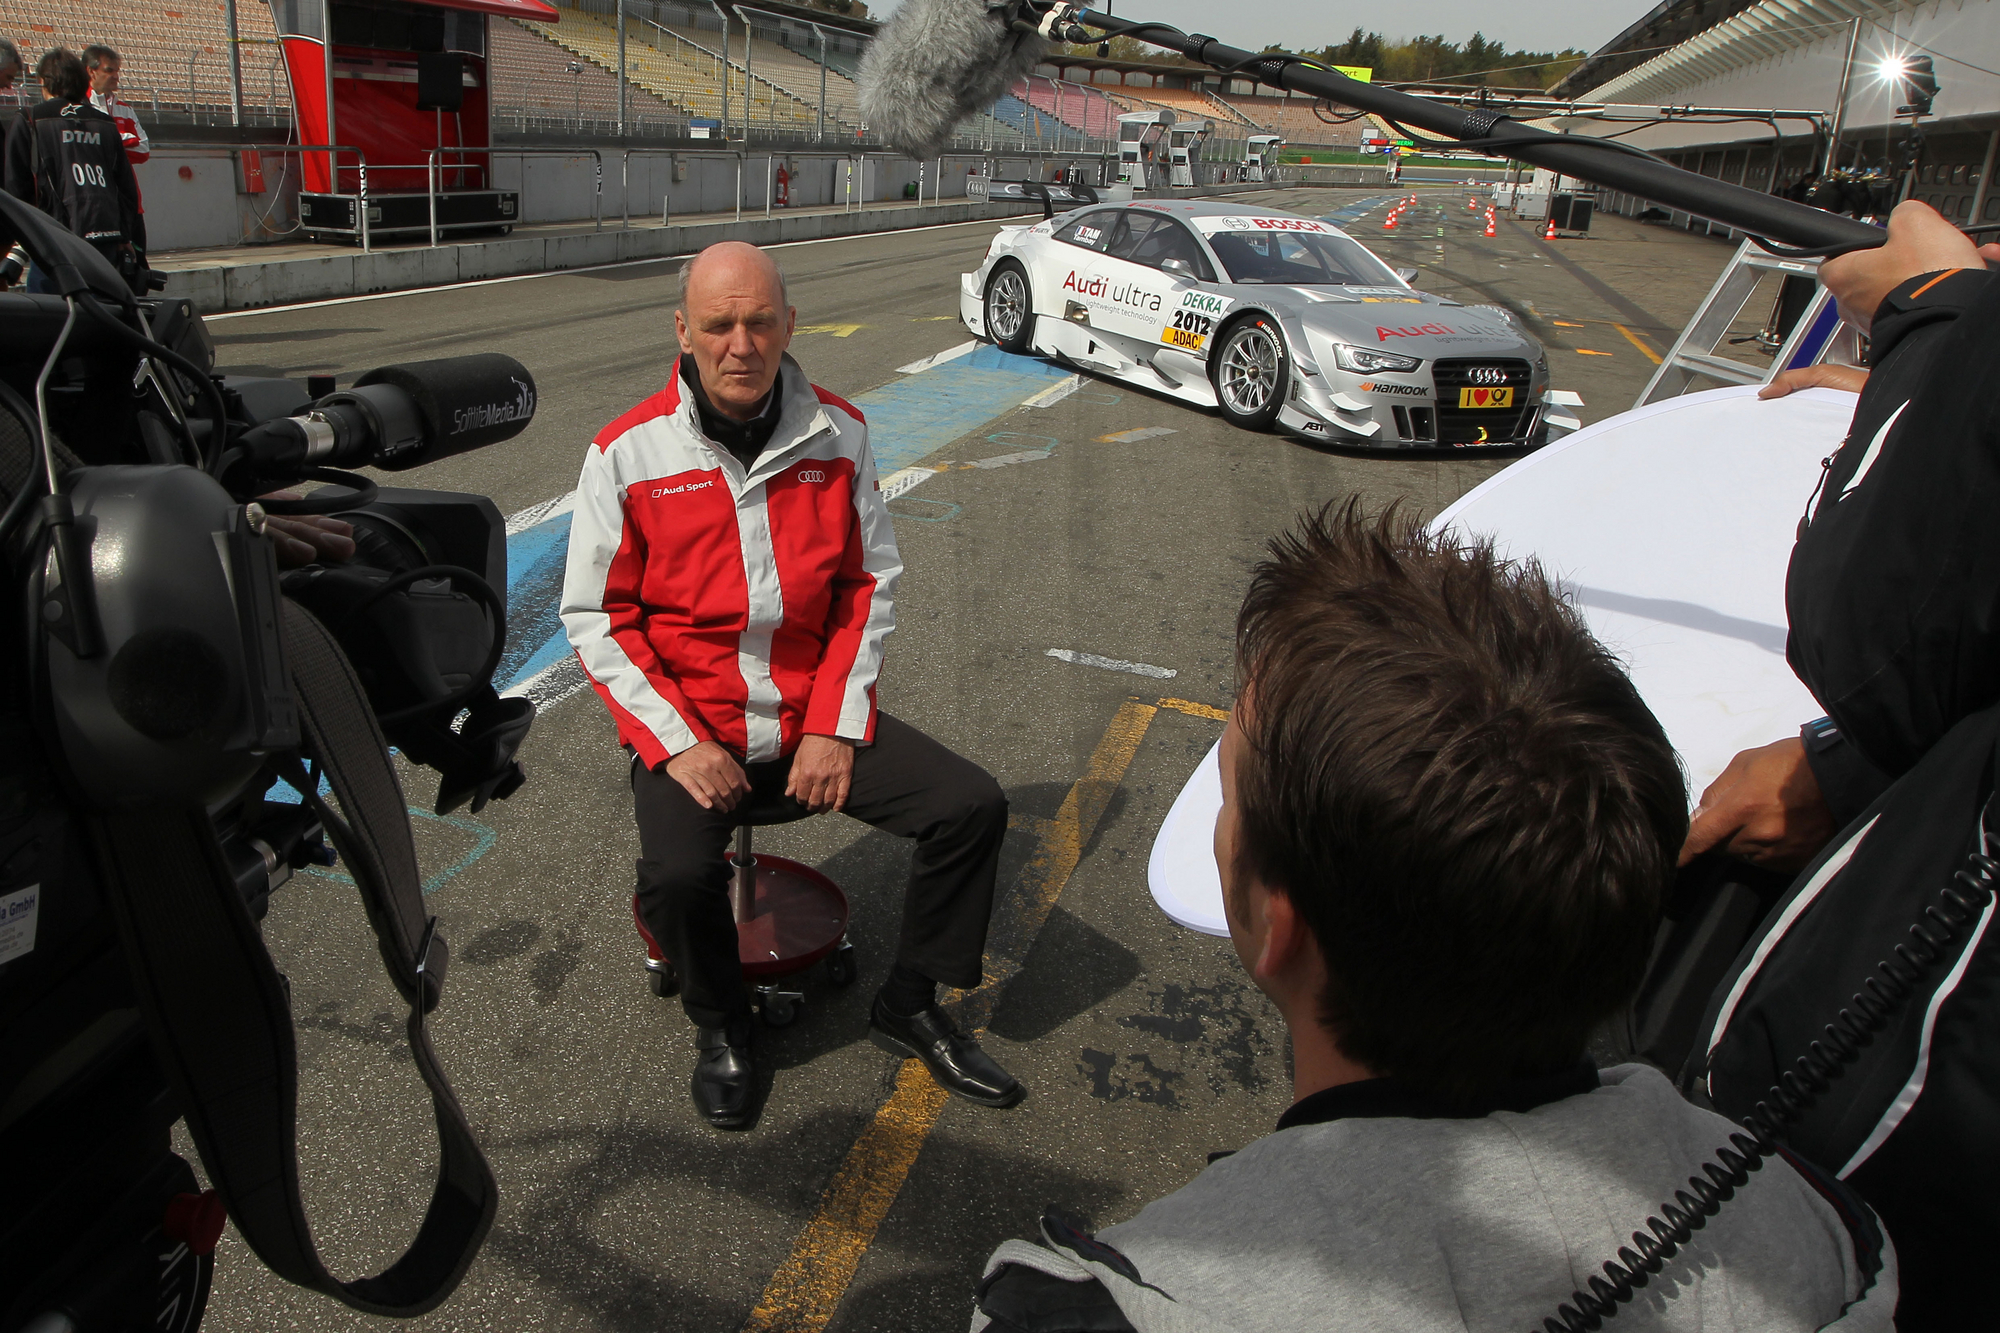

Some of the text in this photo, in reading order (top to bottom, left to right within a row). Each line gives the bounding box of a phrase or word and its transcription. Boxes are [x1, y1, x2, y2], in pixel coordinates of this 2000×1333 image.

[62, 130, 101, 145] DTM
[72, 163, 106, 188] 008
[1084, 226, 1102, 240] TAM
[1252, 218, 1328, 233] BOSCH
[1073, 233, 1097, 246] Tambay
[1062, 270, 1162, 312] Audi ultra
[1086, 299, 1158, 325] lightweight technology
[1182, 291, 1223, 315] DEKRA
[1172, 310, 1211, 336] 2012
[1375, 322, 1457, 342] Audi
[1172, 332, 1199, 349] ADAC
[1301, 421, 1323, 432] ABT
[662, 480, 714, 496] Audi Sport
[9, 894, 36, 916] GmbH
